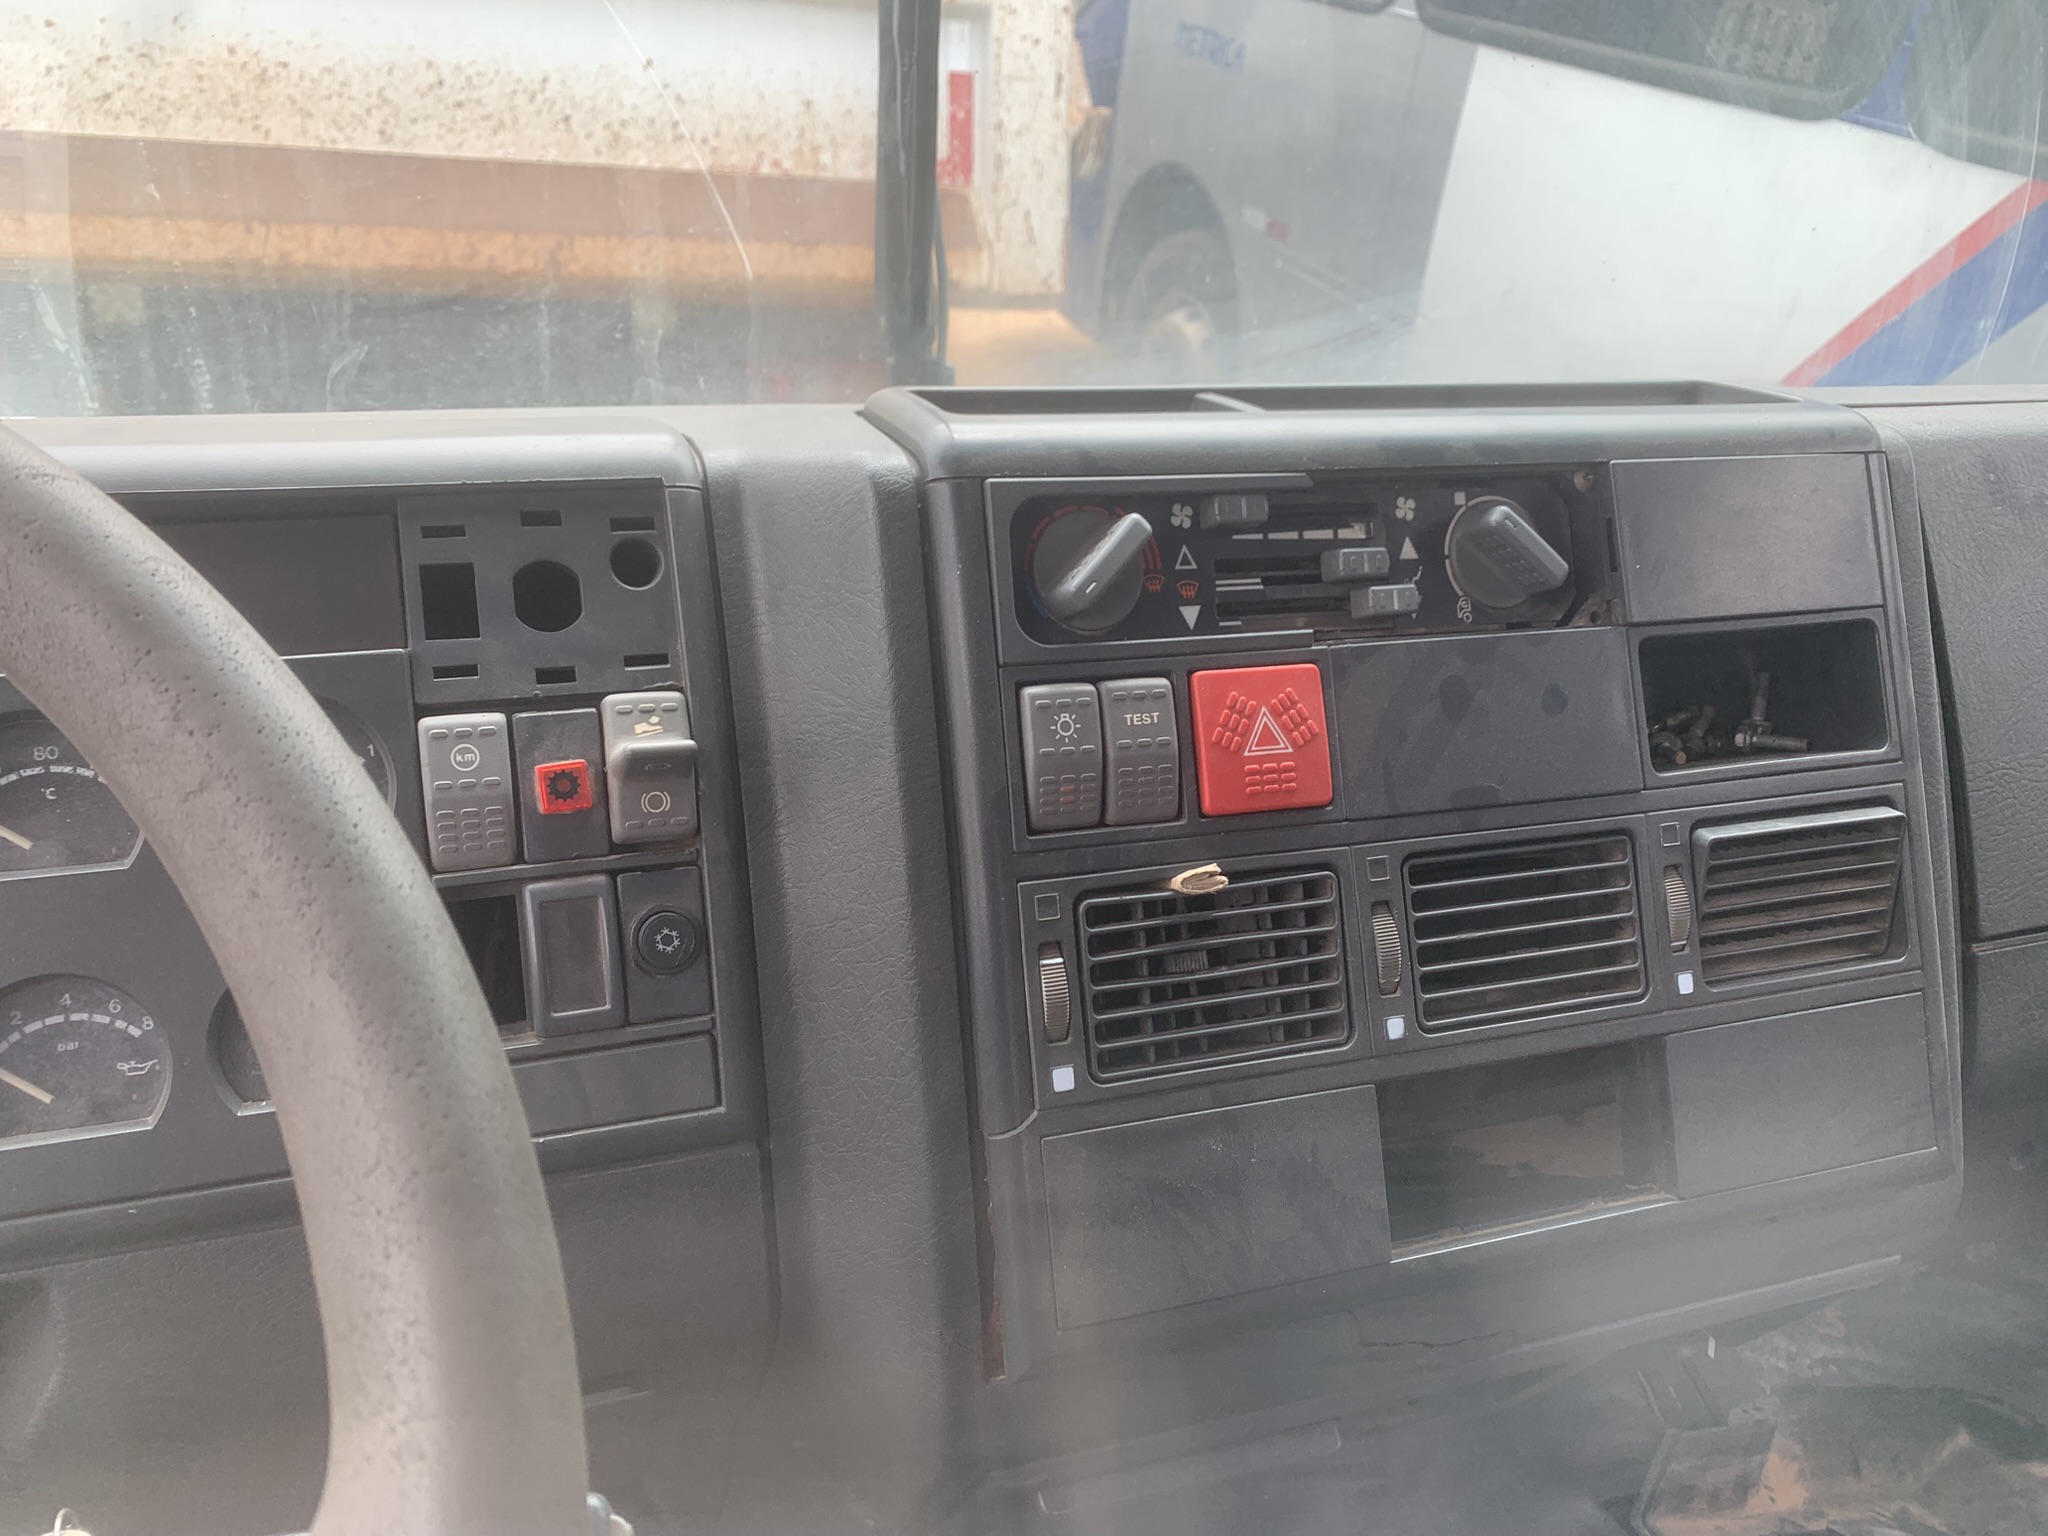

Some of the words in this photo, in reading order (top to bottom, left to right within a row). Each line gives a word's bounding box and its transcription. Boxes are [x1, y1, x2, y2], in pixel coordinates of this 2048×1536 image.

[1124, 713, 1160, 726] TEST
[33, 746, 59, 761] 80
[366, 743, 376, 757] 1
[455, 750, 477, 763] km
[10, 1011, 23, 1025] 2
[59, 993, 72, 1008] 4
[108, 999, 121, 1013] 6
[142, 1015, 155, 1031] 8
[57, 1040, 80, 1052] bar
